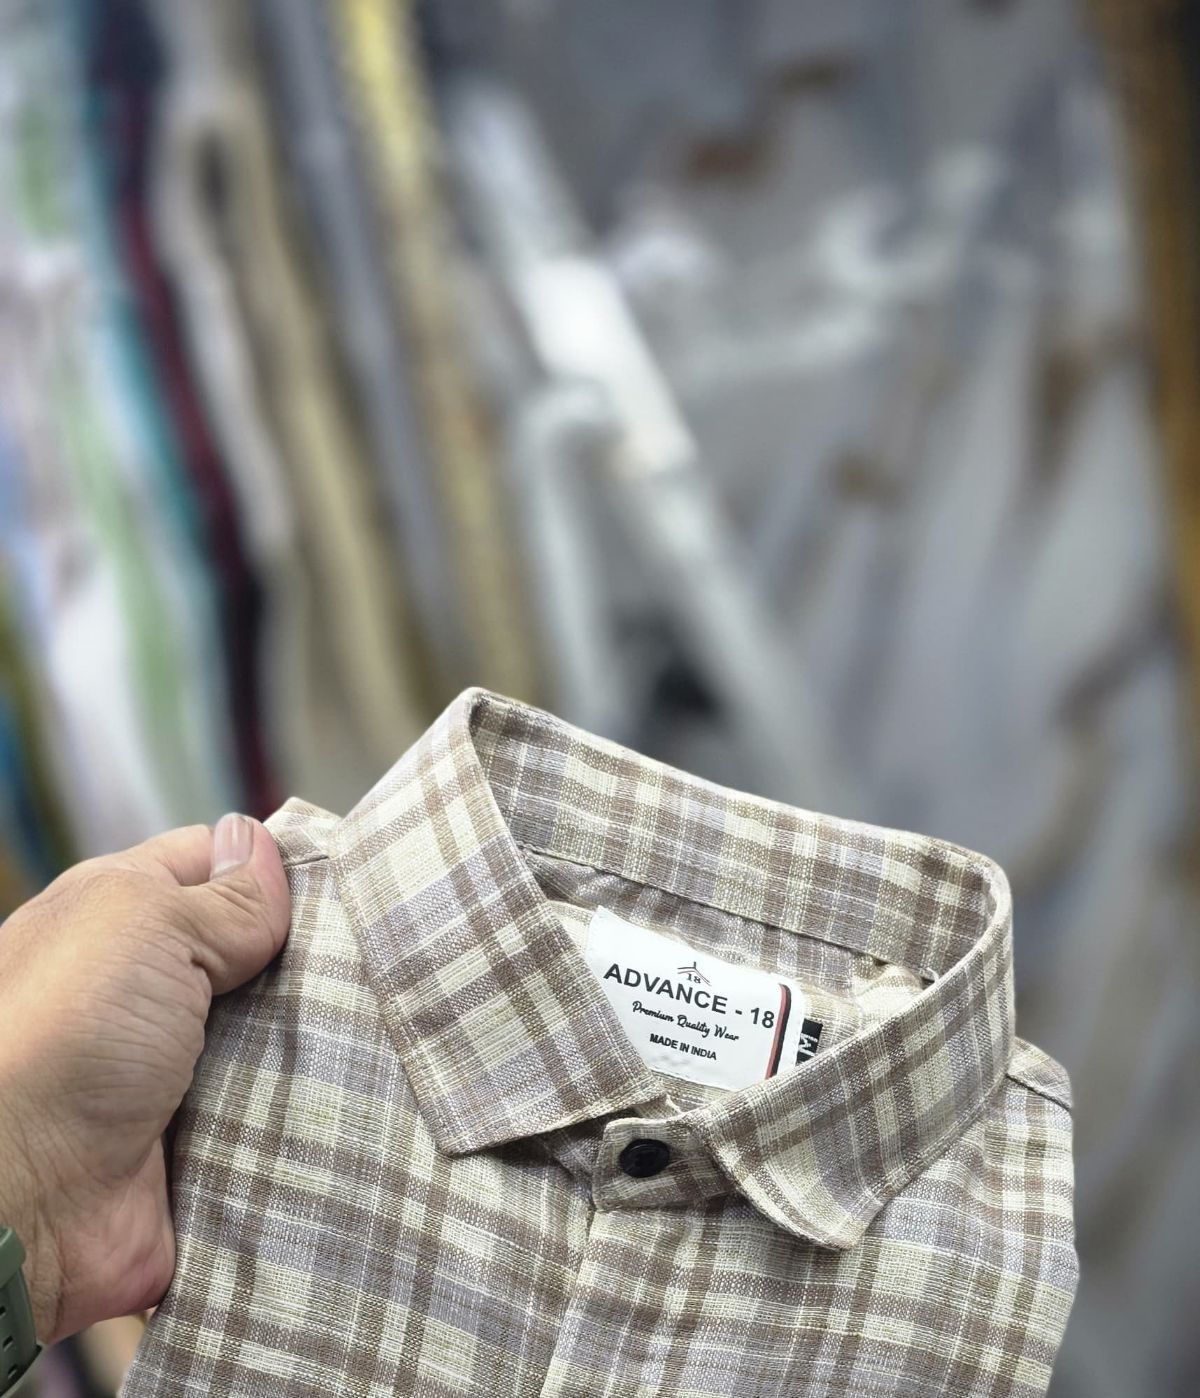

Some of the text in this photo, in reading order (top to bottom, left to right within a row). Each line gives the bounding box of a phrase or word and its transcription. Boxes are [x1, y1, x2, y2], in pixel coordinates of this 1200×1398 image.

[603, 963, 728, 1015] ADVANCE
[750, 1007, 775, 1029] 18
[632, 1000, 740, 1041] Premium Quality Wear
[649, 1033, 717, 1061] MADE IN INDIA
[799, 1032, 818, 1057] M
